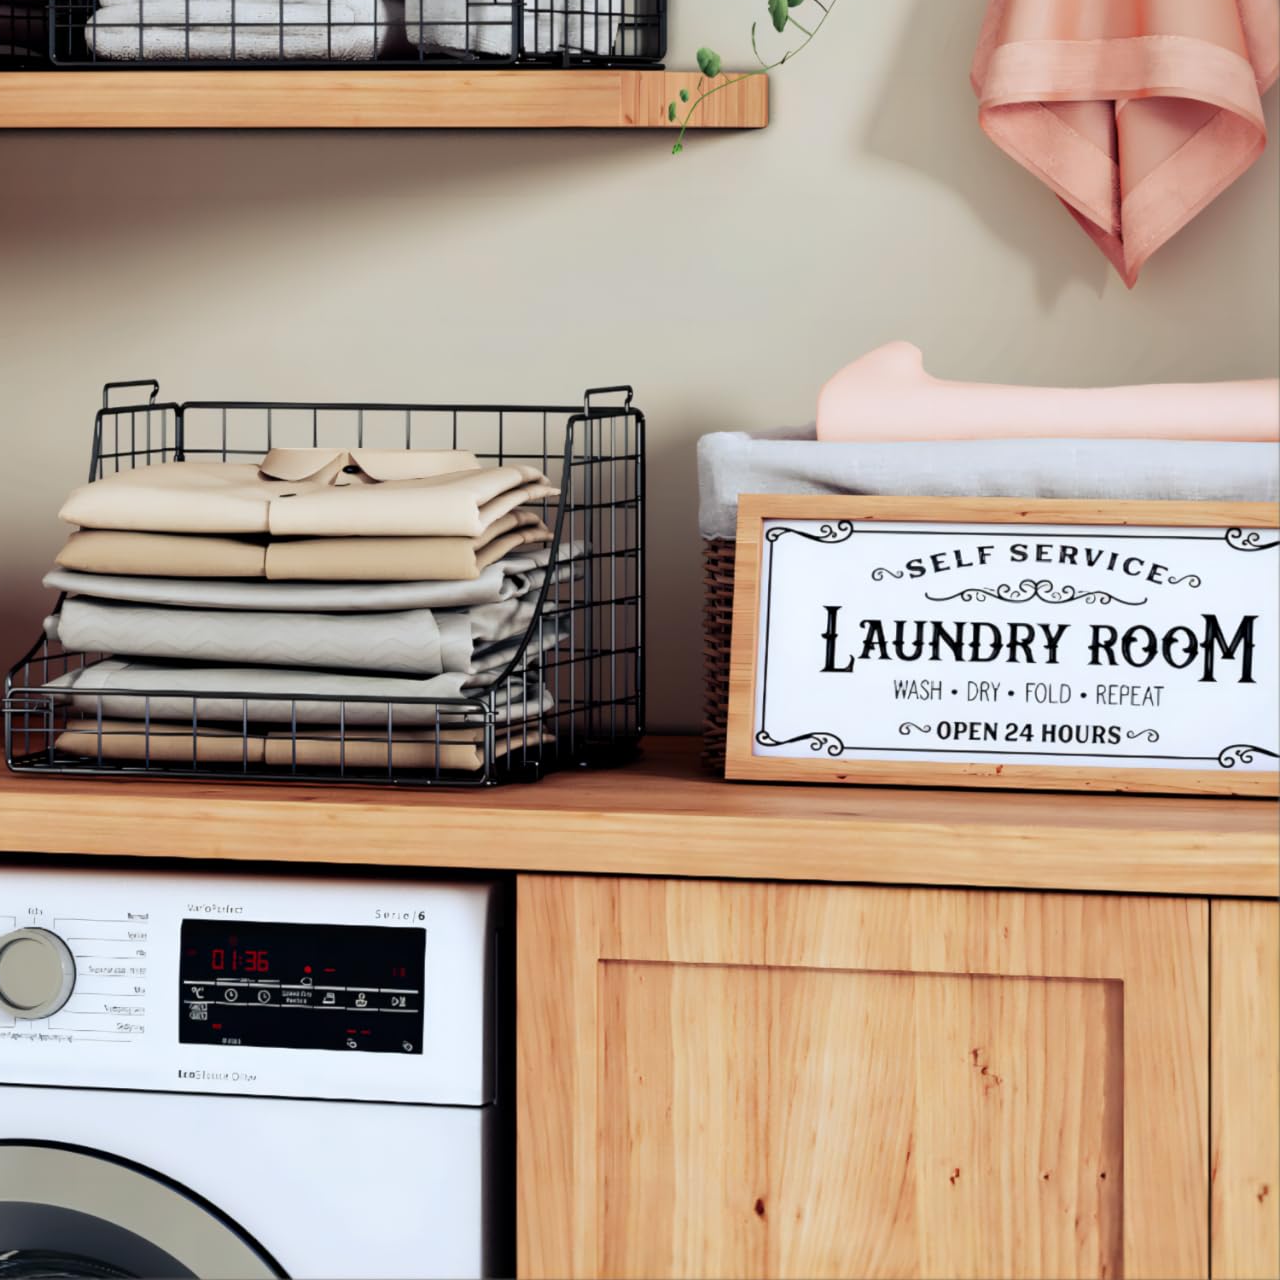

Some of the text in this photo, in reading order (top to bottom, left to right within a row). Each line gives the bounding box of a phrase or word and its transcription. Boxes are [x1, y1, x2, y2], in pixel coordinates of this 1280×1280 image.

[905, 543, 1169, 585] SELF SERVICE
[819, 605, 1260, 683] LAUNDRY ROOM
[894, 679, 1165, 707] WASH DRY FOLD REPEAT
[936, 720, 1122, 745] OPEN 24 HOURS
[211, 948, 269, 972] 01:36
